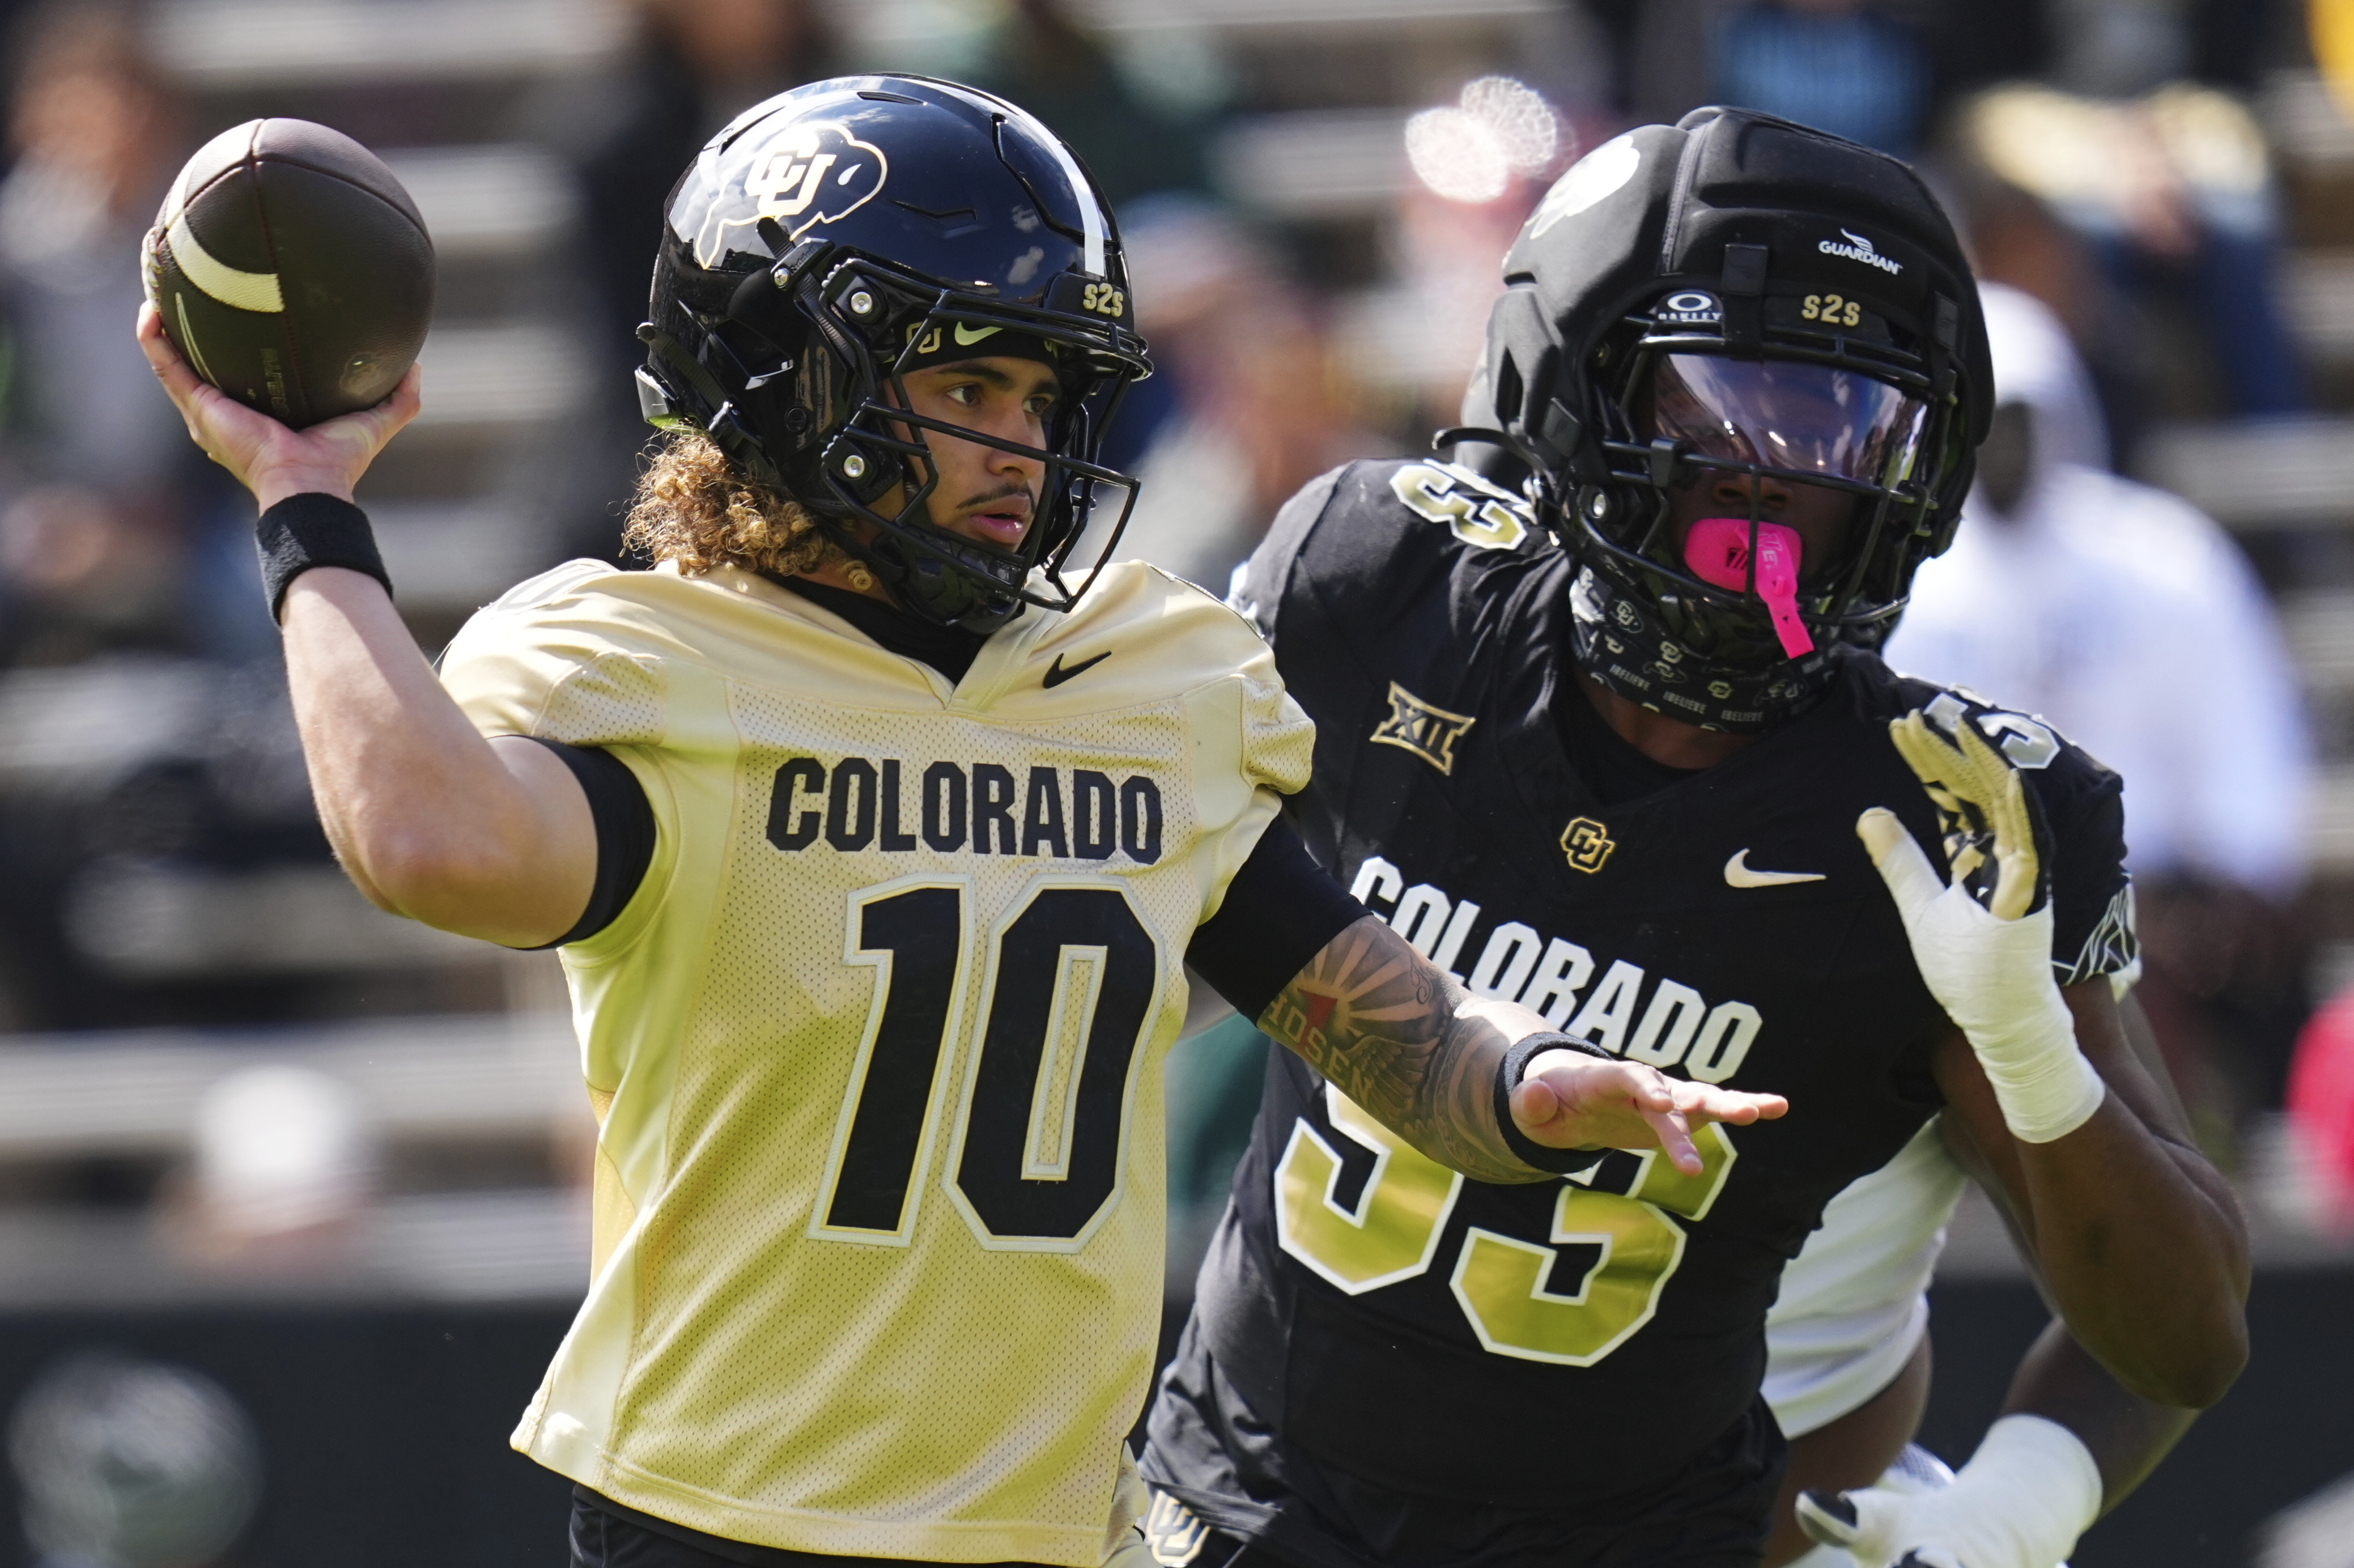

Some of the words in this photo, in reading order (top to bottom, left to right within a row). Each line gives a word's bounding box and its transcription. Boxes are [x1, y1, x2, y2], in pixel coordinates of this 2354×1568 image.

[1082, 282, 1124, 318] S2S
[1801, 294, 1861, 327] S2S
[766, 757, 1163, 865] COLORADO
[1560, 816, 1617, 874] CU
[1349, 855, 1763, 1084] COLORADO
[806, 872, 1167, 1255] 10
